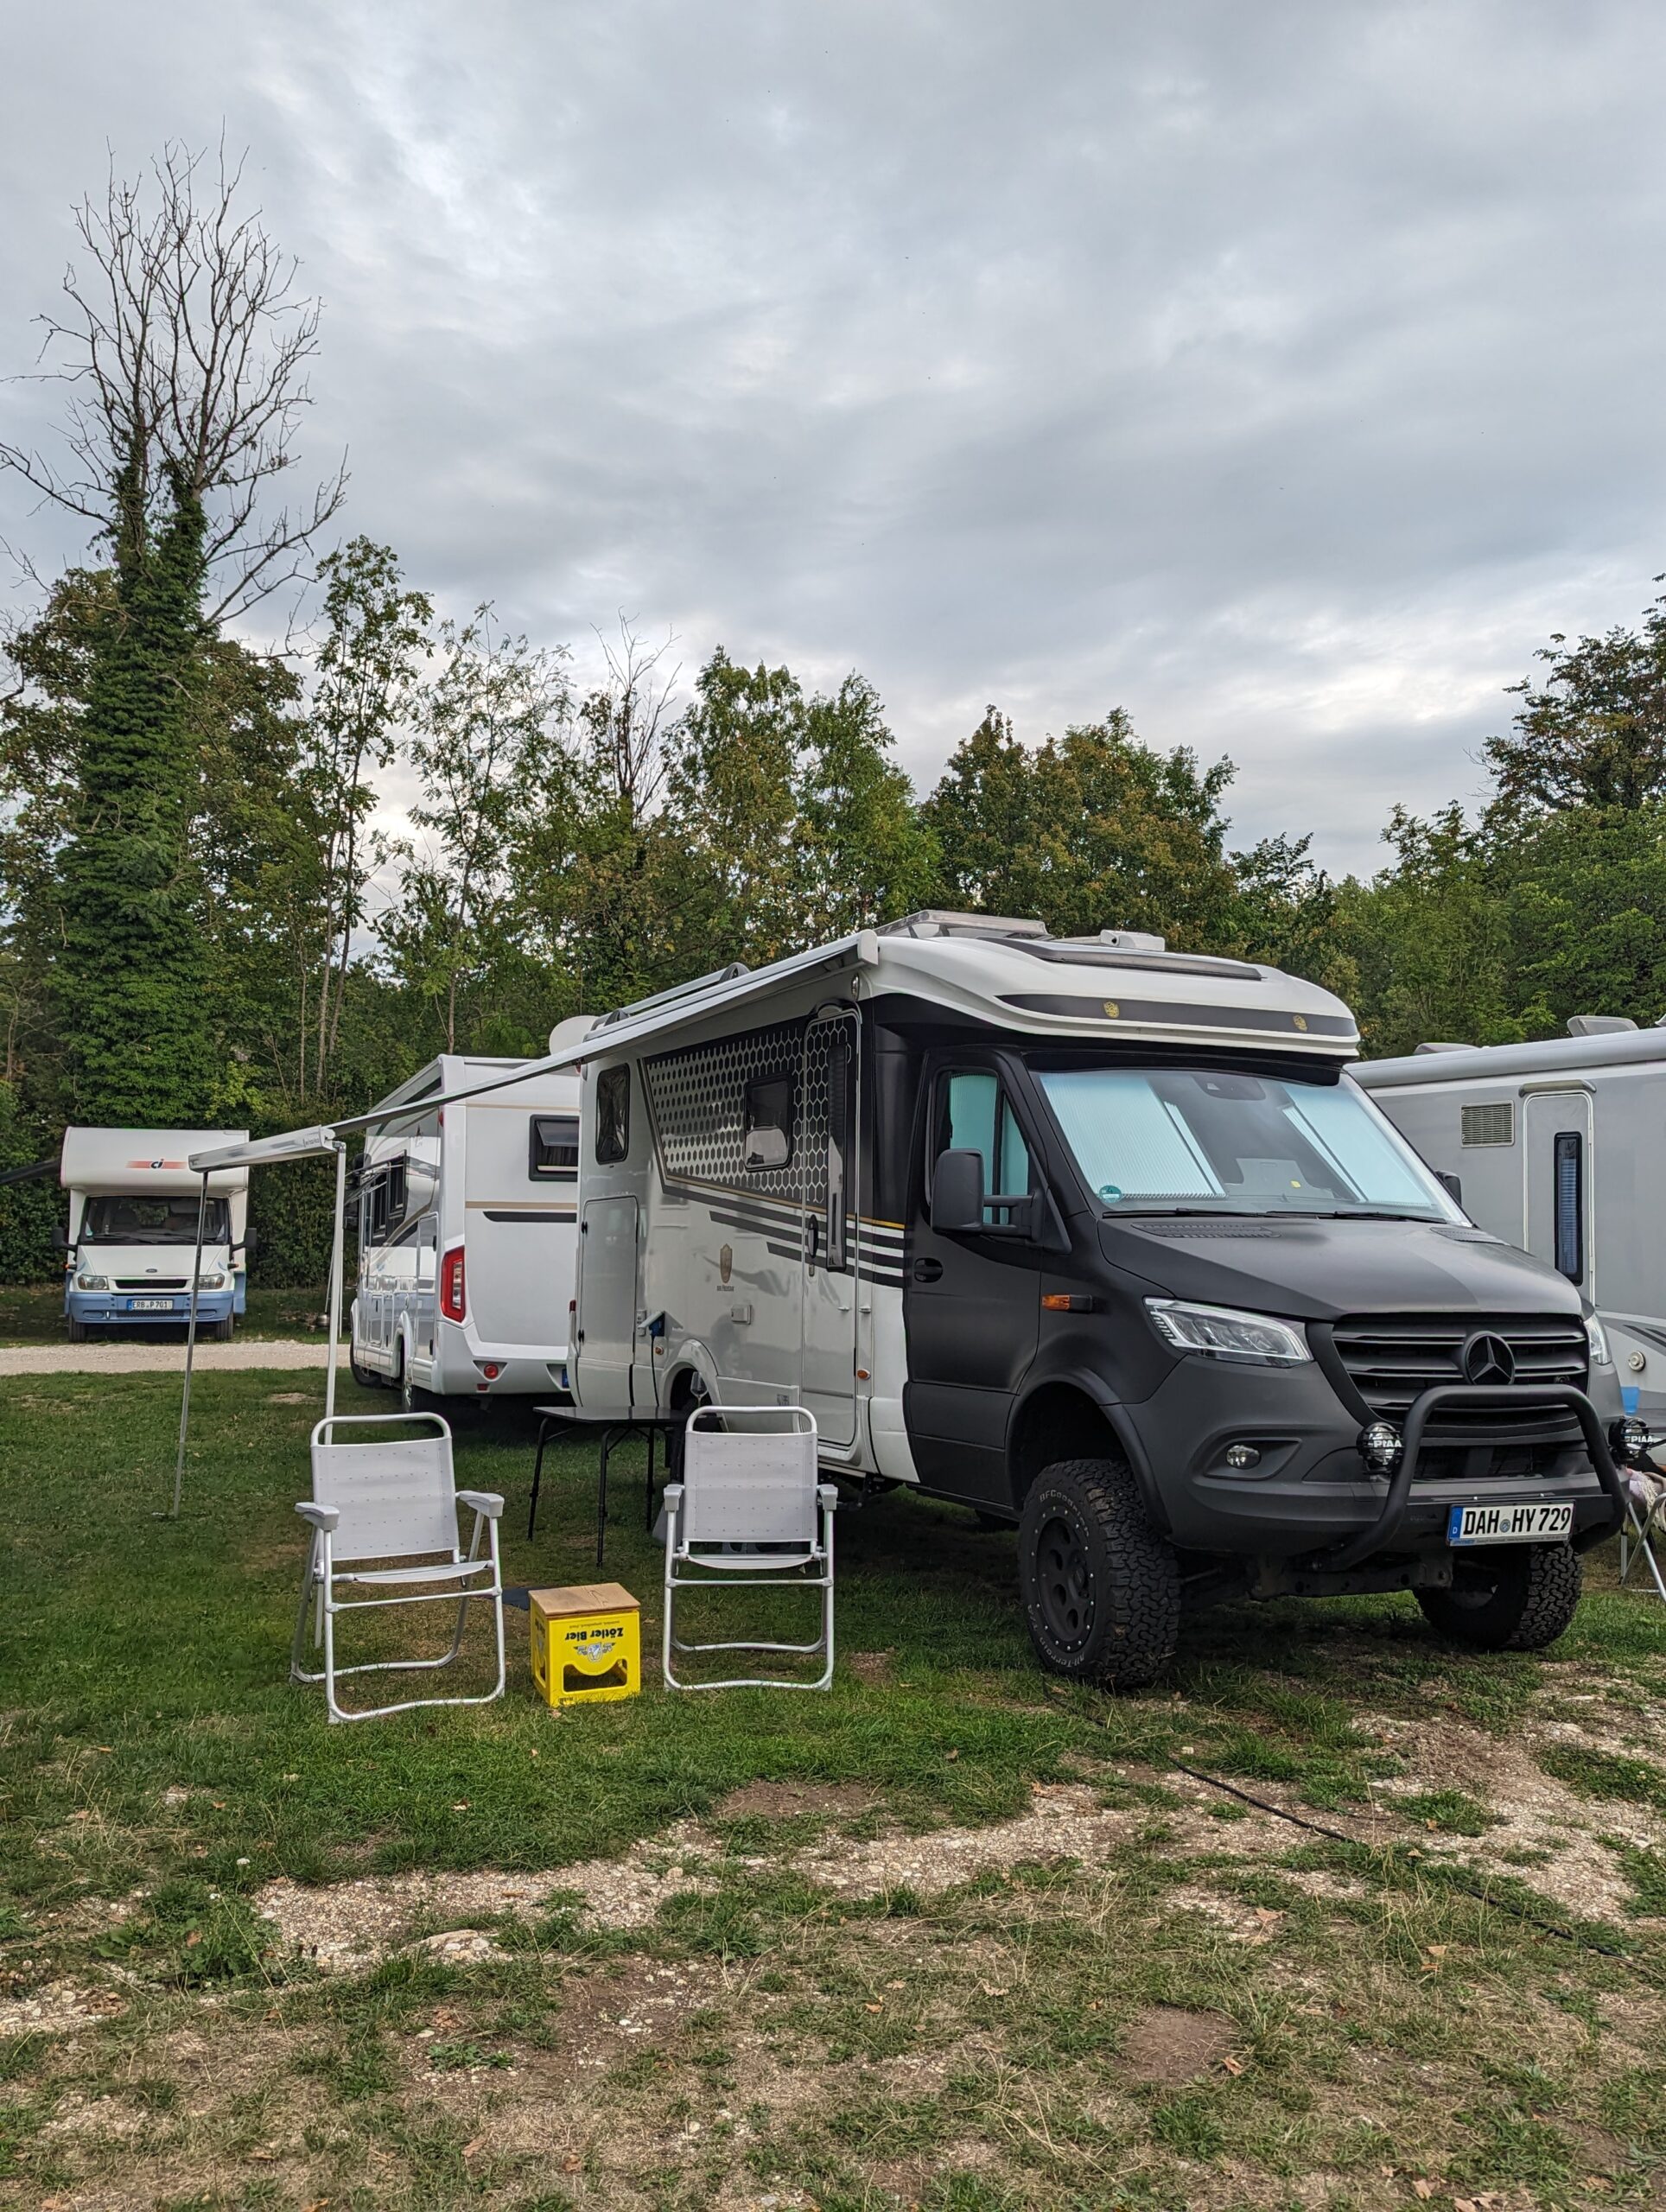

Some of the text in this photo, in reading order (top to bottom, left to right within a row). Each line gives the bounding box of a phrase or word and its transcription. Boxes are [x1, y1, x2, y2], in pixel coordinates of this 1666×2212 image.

[1463, 1507, 1571, 1535] DAH HY 729
[564, 1628, 623, 1642] Zötler Bier
